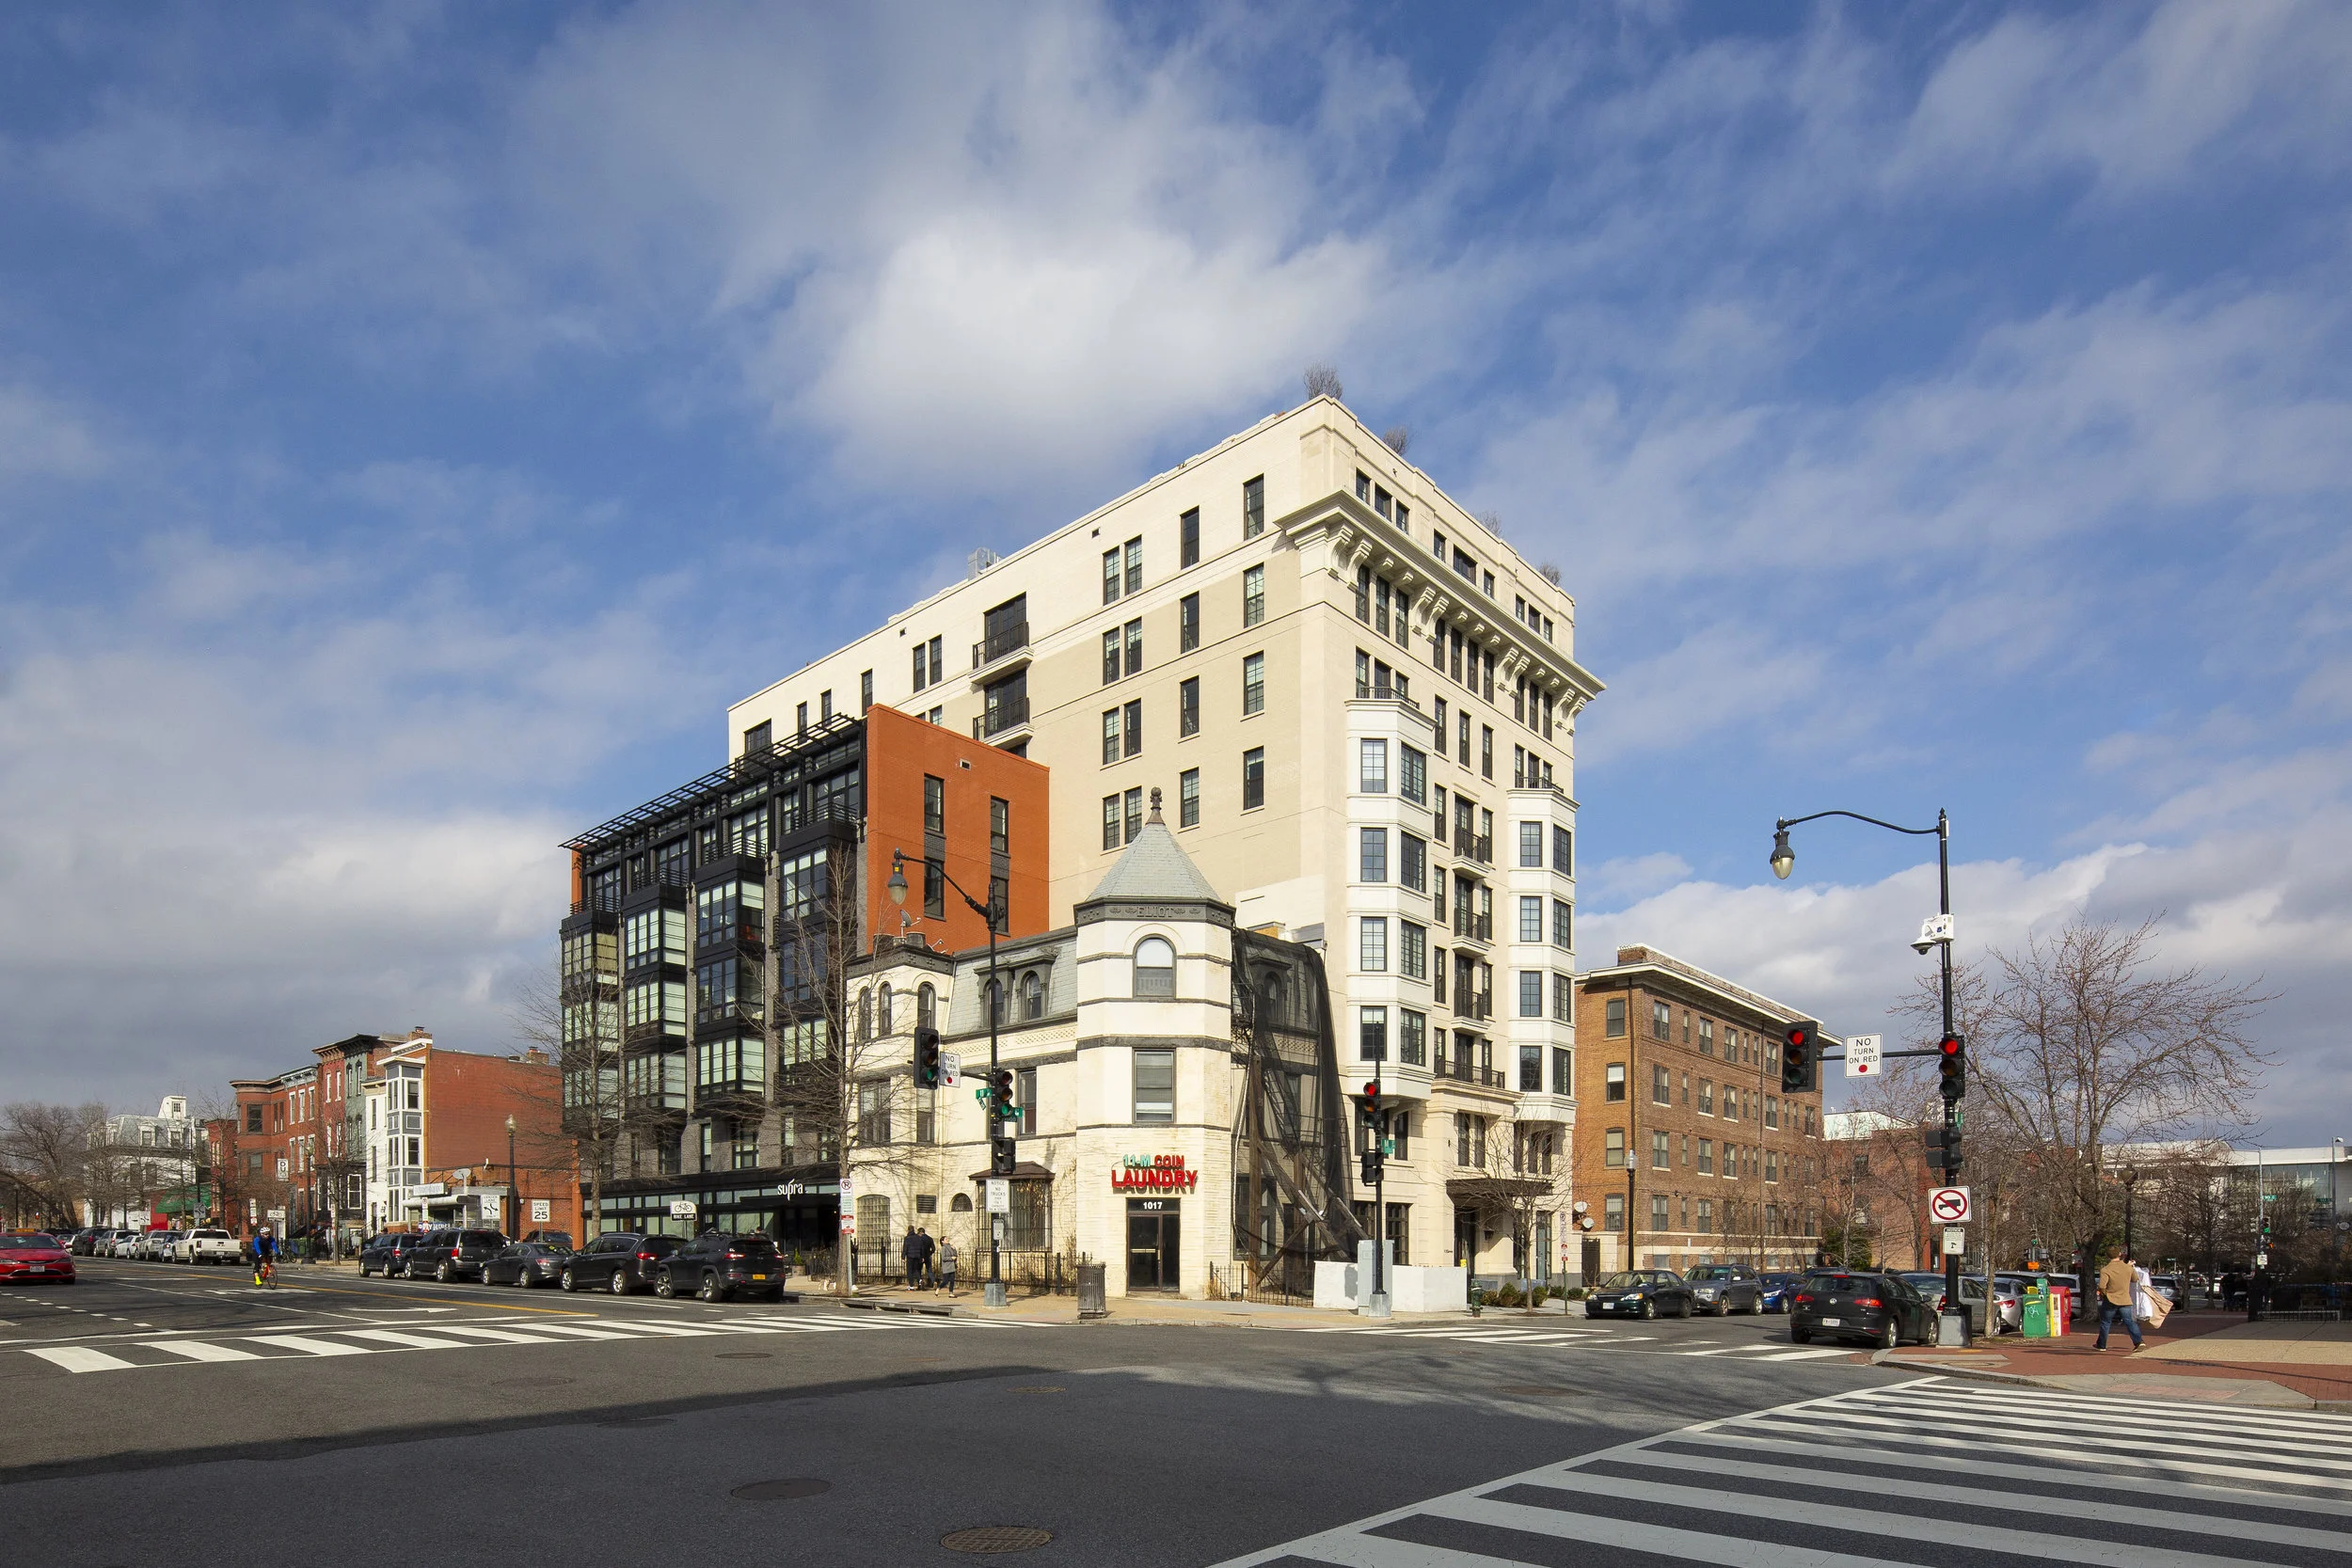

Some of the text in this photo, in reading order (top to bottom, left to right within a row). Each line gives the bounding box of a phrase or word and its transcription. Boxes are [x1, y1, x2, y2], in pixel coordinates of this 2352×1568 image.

[1136, 906, 1174, 918] ELIOT
[1856, 1037, 1871, 1047] NO
[1854, 1047, 1874, 1055] TURN
[1864, 1054, 1879, 1063] RED
[943, 1062, 957, 1070] TURN
[1122, 1154, 1184, 1168] 11-M COIN
[1111, 1169, 1198, 1188] LAUNDRY
[777, 1179, 803, 1201] supra
[1143, 1201, 1163, 1210] 1017
[534, 1211, 548, 1220] 25
